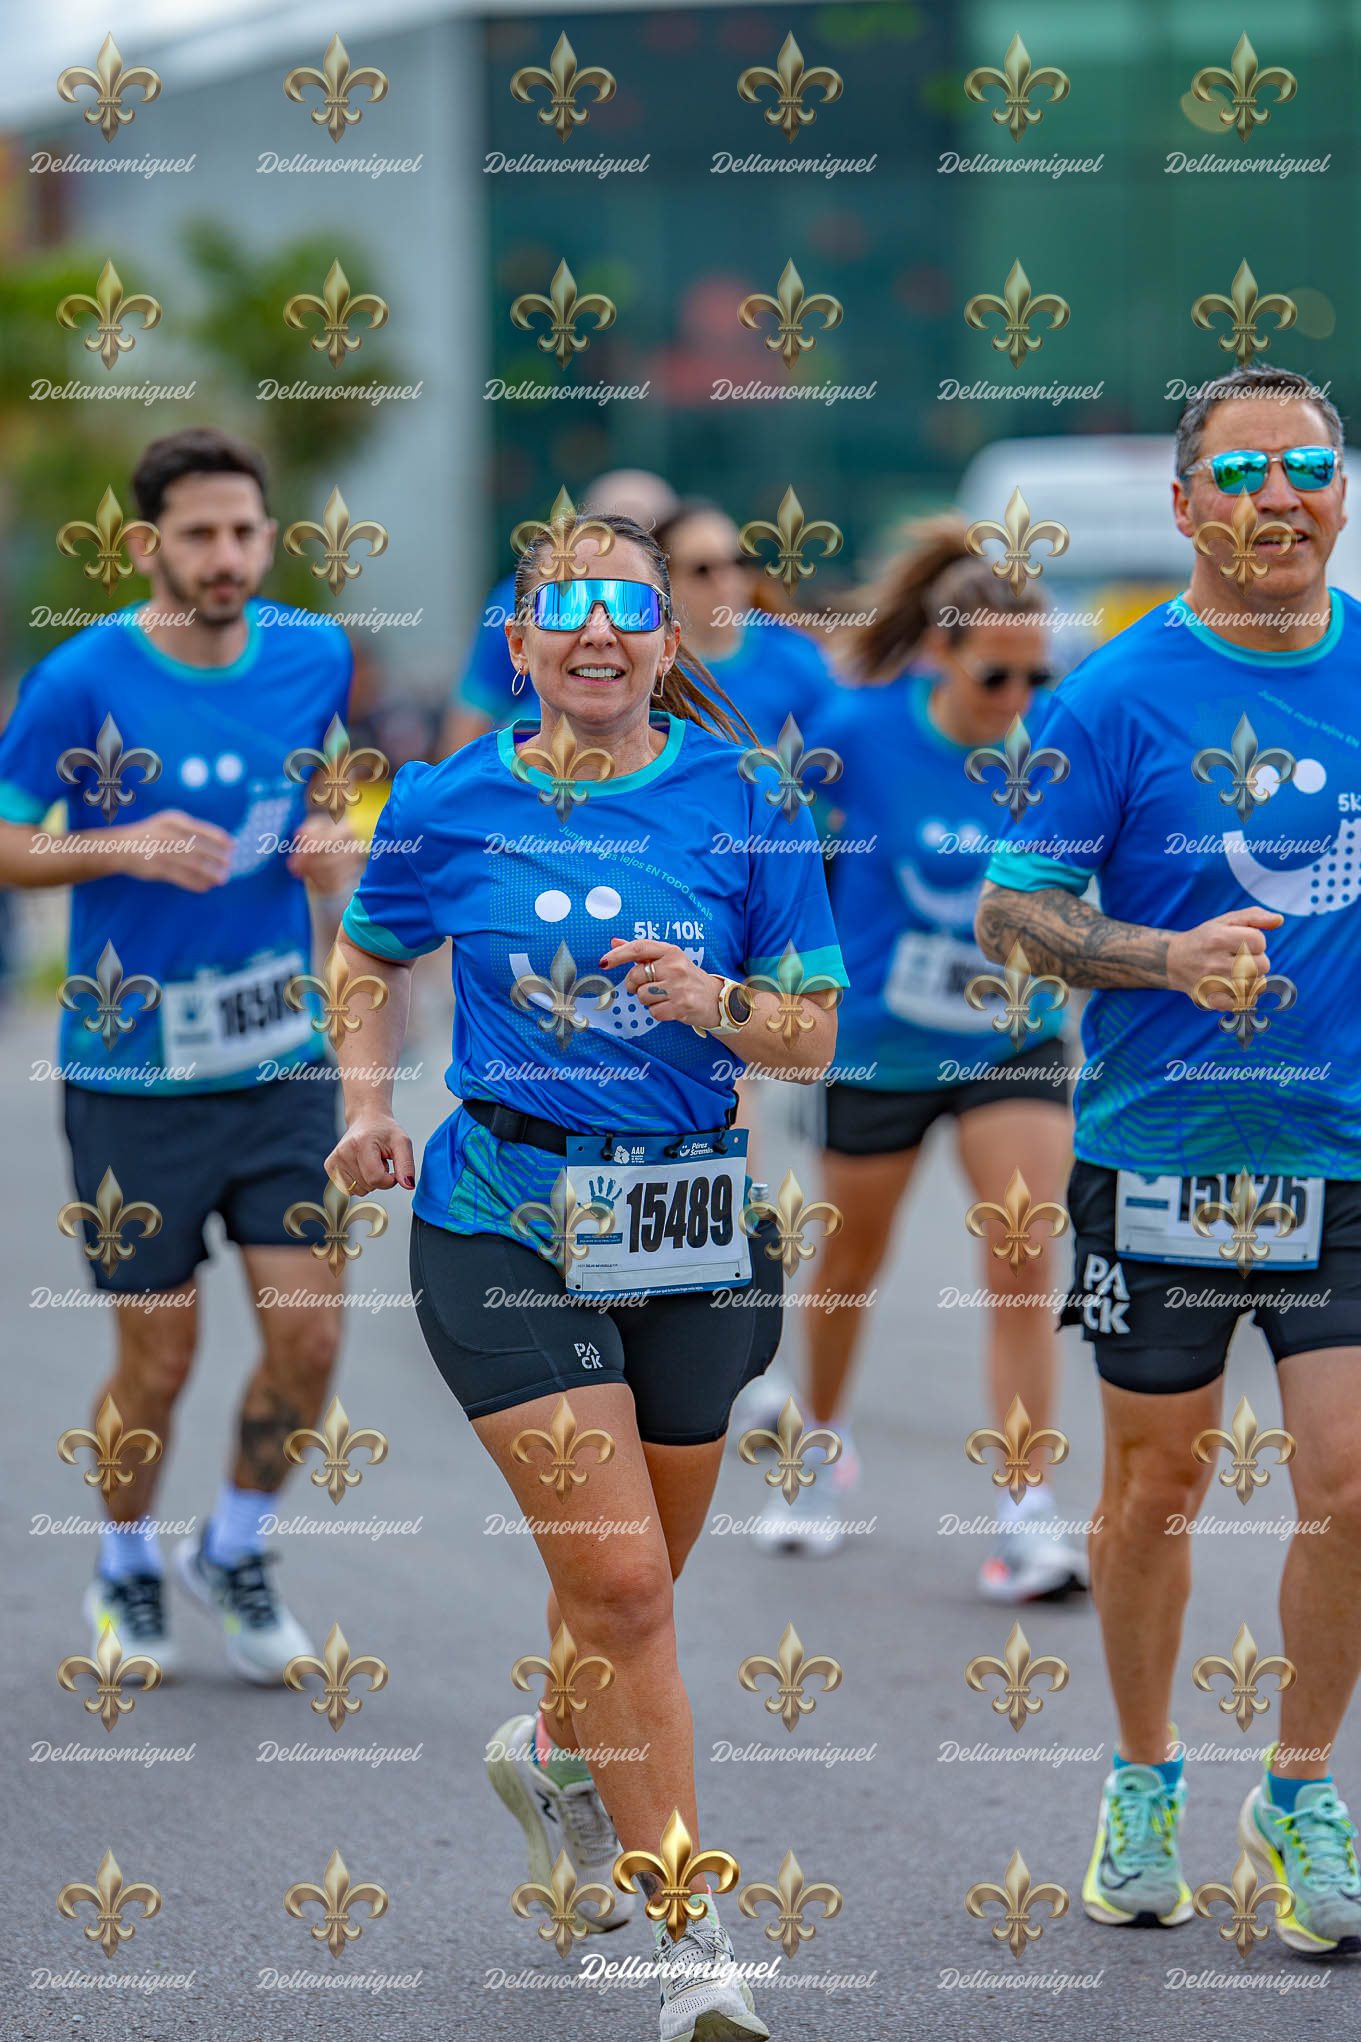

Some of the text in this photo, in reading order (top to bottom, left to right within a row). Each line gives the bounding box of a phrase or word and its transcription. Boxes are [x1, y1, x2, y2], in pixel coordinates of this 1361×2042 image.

[661, 871, 690, 894] TODO
[631, 1146, 645, 1154] AAU
[626, 1174, 734, 1253] 15489
